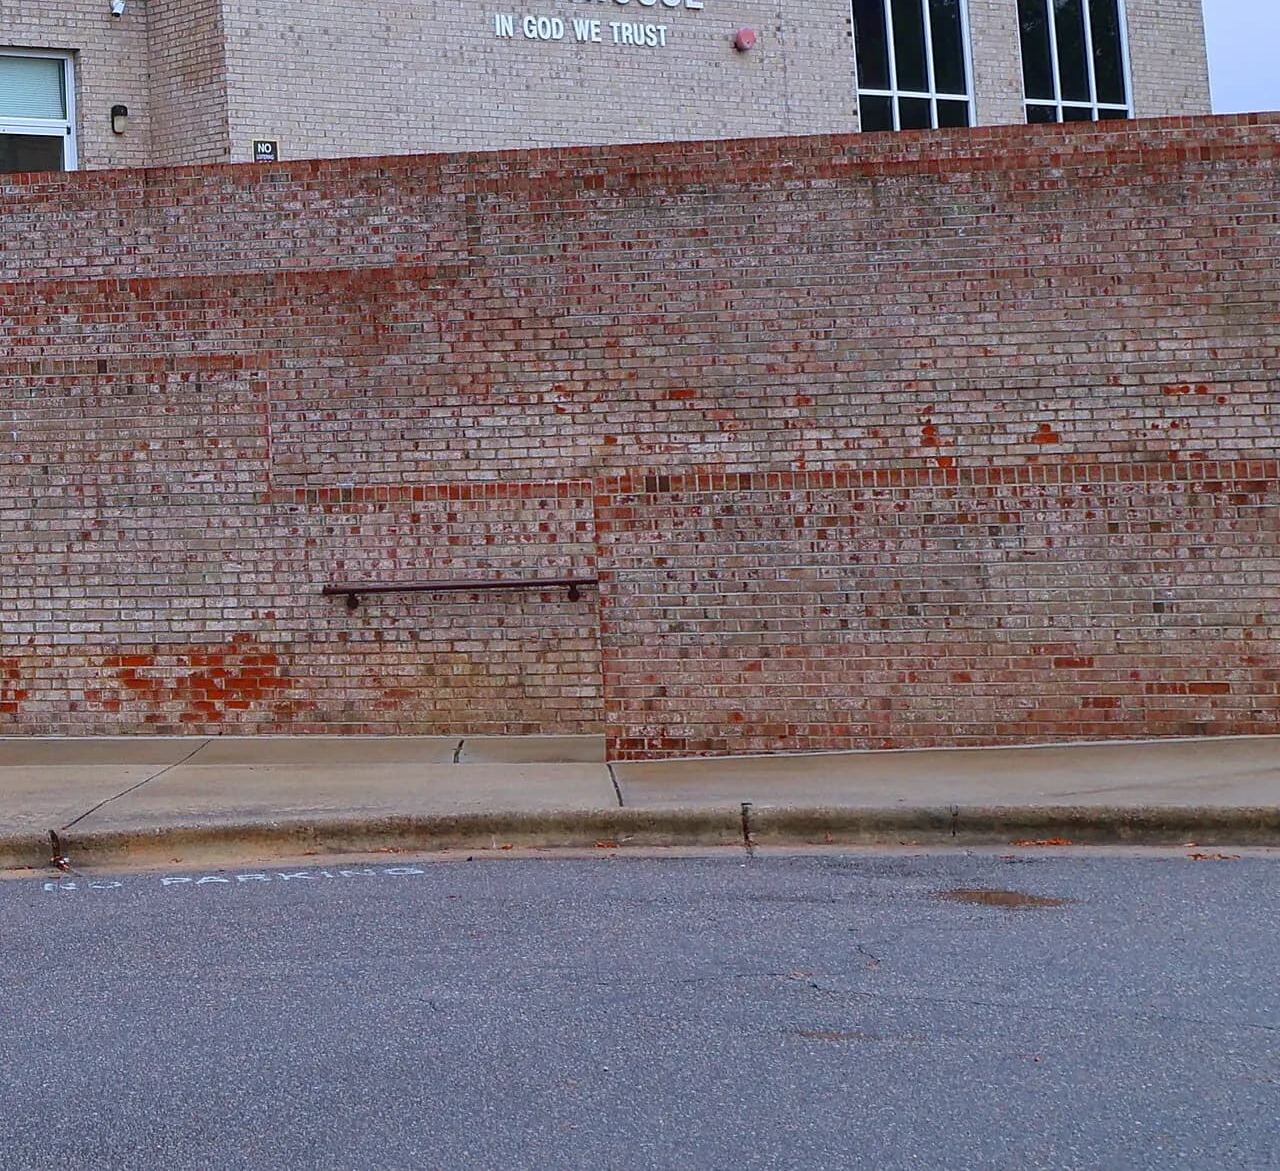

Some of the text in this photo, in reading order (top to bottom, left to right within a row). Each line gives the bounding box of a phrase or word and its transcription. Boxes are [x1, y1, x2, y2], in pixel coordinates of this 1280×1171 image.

[494, 12, 668, 47] IN GOD WE TRUST
[257, 143, 272, 153] NO
[160, 867, 425, 885] PARKING
